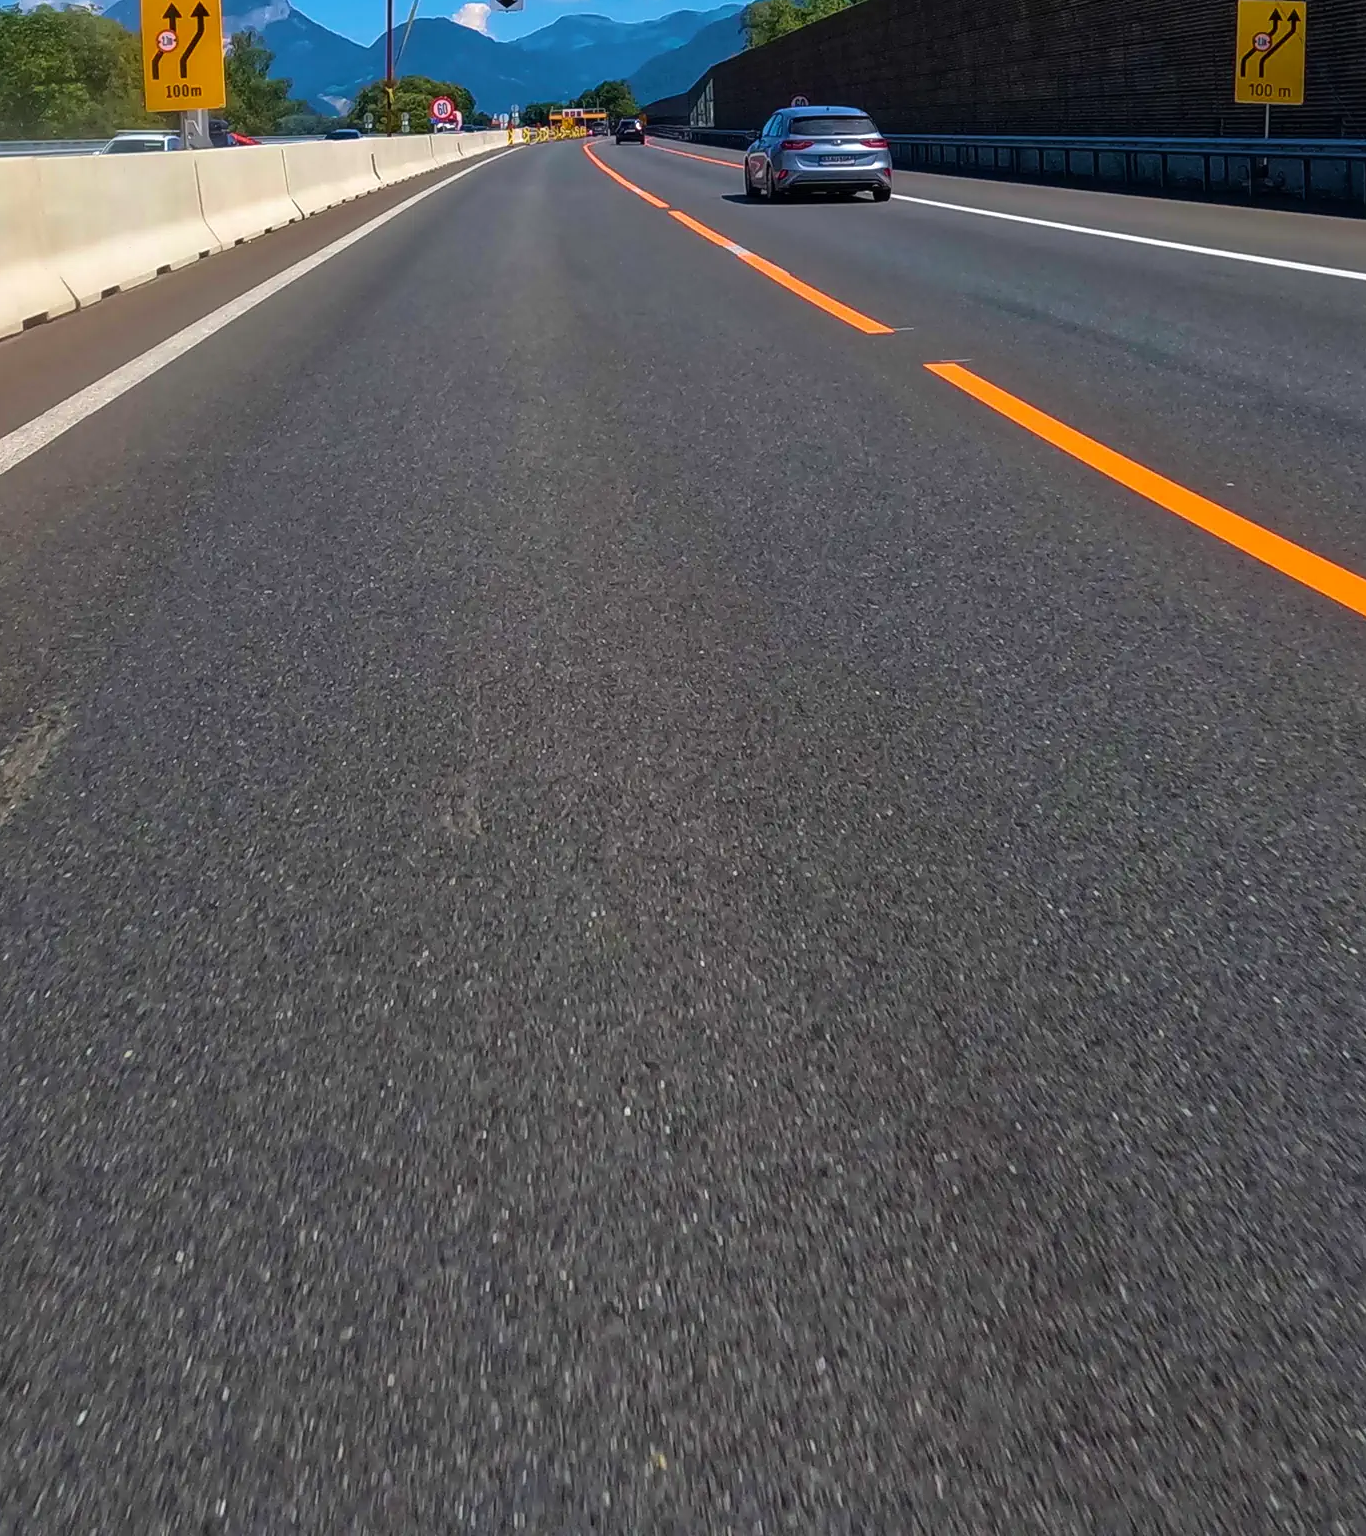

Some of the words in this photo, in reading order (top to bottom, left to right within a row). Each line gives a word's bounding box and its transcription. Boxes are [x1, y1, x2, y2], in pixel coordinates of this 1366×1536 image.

[165, 84, 202, 98] 100m
[1248, 83, 1273, 97] 100
[1278, 87, 1291, 98] m
[437, 102, 448, 115] 60
